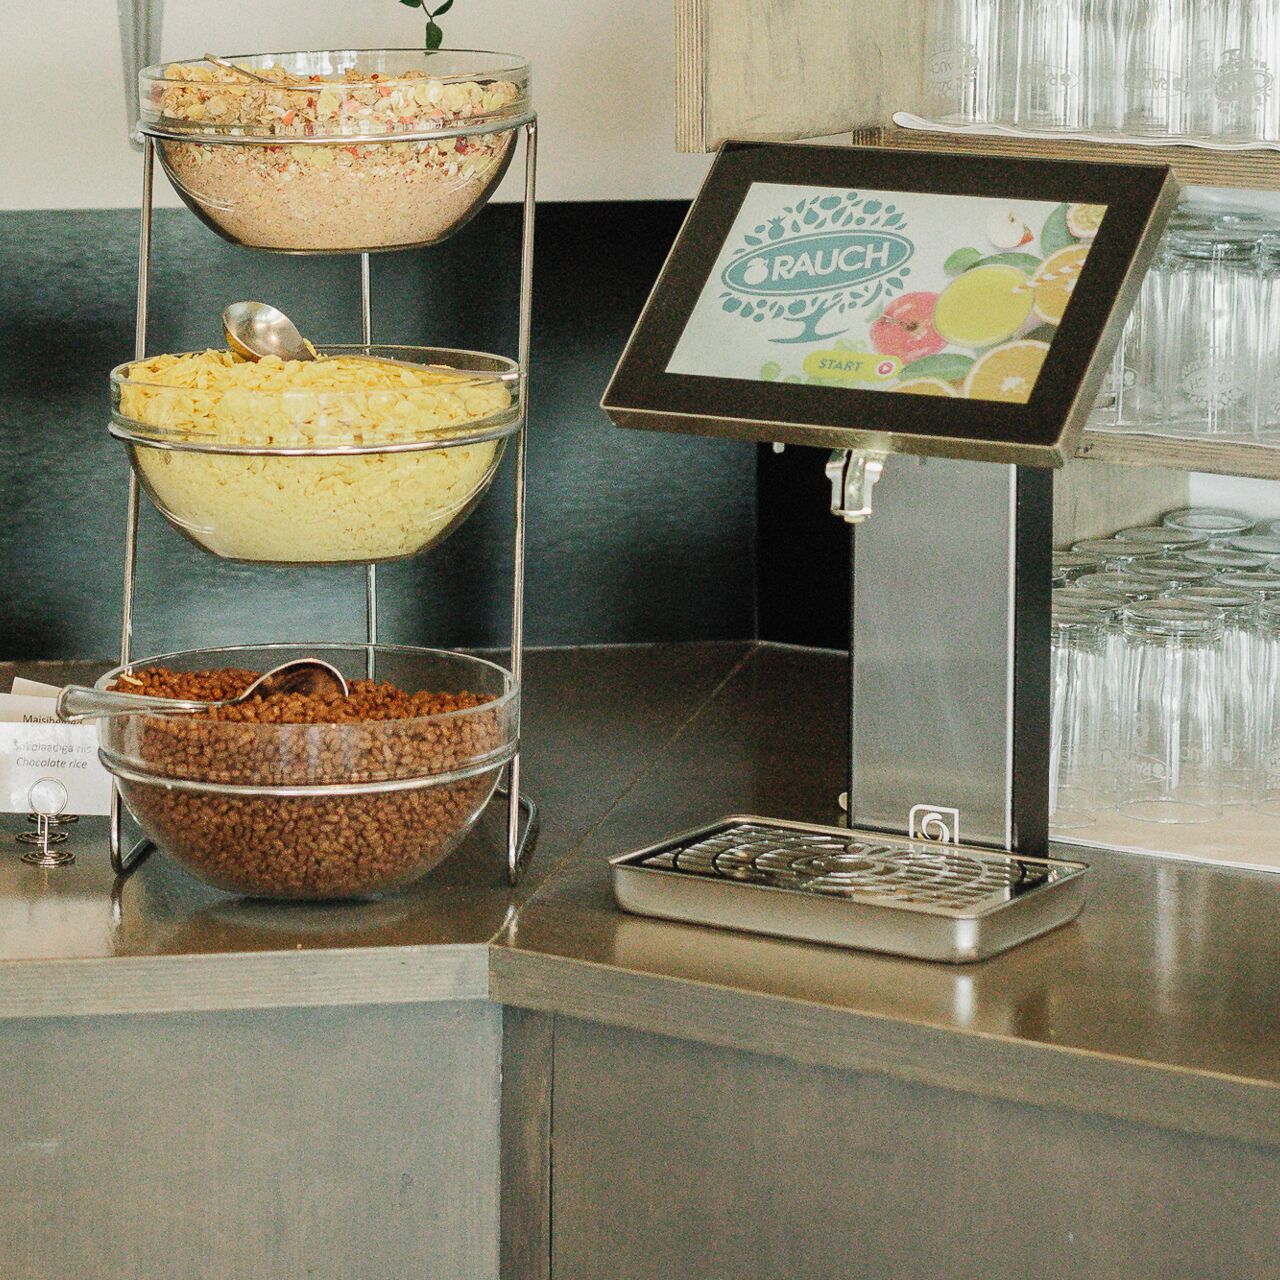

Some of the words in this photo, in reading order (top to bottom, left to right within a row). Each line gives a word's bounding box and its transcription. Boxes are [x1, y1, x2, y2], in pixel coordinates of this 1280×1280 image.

[771, 241, 891, 281] RAUCH
[818, 358, 864, 371] START
[16, 757, 67, 769] Chocolate
[69, 759, 88, 769] rice
